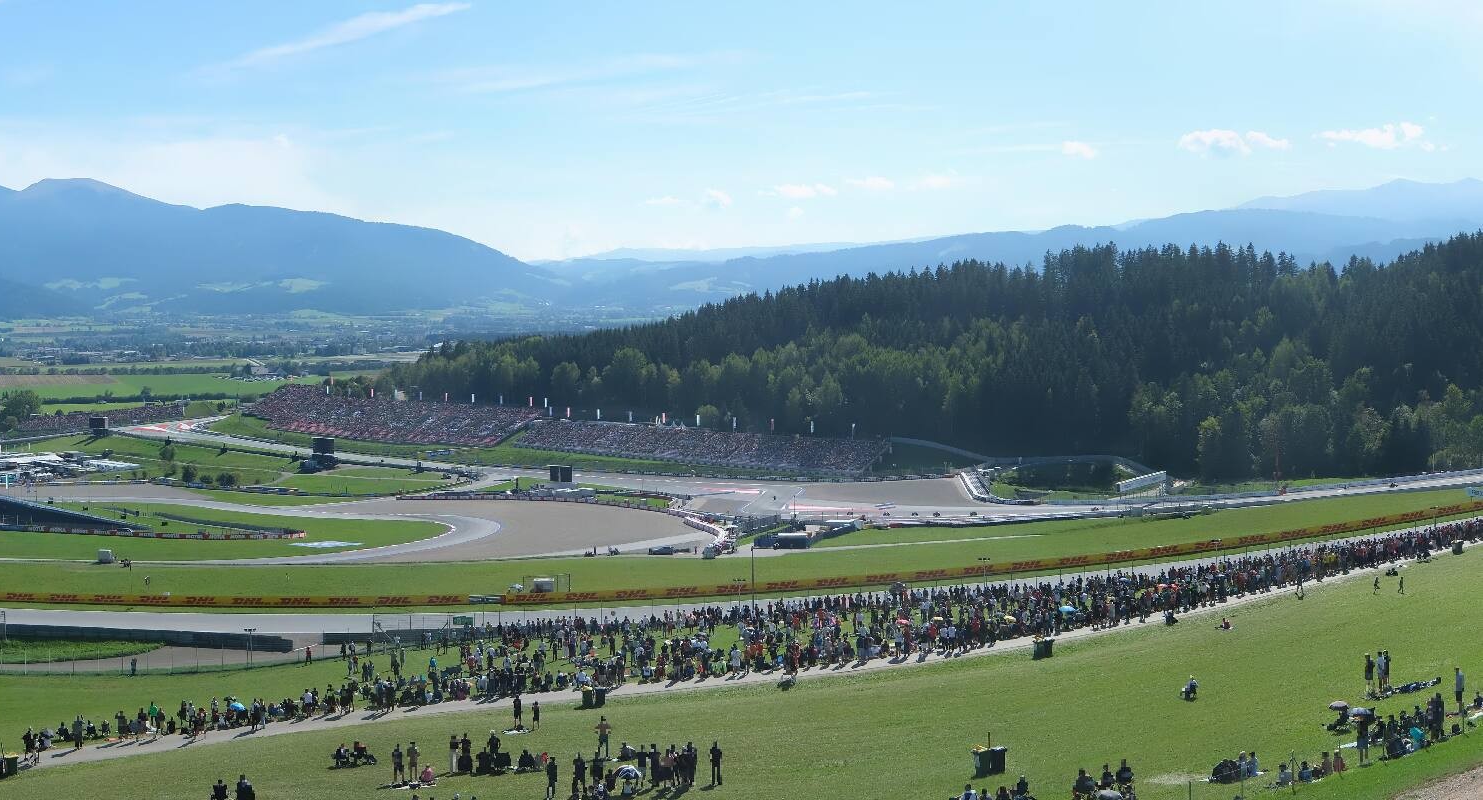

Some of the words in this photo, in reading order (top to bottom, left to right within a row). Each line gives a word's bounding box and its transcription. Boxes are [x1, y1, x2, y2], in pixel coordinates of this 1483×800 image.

[1150, 545, 1179, 554] DHL
[1106, 550, 1134, 560] DHL
[1012, 560, 1040, 569] DHL
[1059, 556, 1088, 565] DHL
[915, 570, 946, 578] DHL
[766, 581, 798, 589] DHL
[817, 578, 848, 586] DHL
[717, 584, 747, 592] DHL
[516, 593, 547, 601] DHL
[616, 590, 647, 598] DHL
